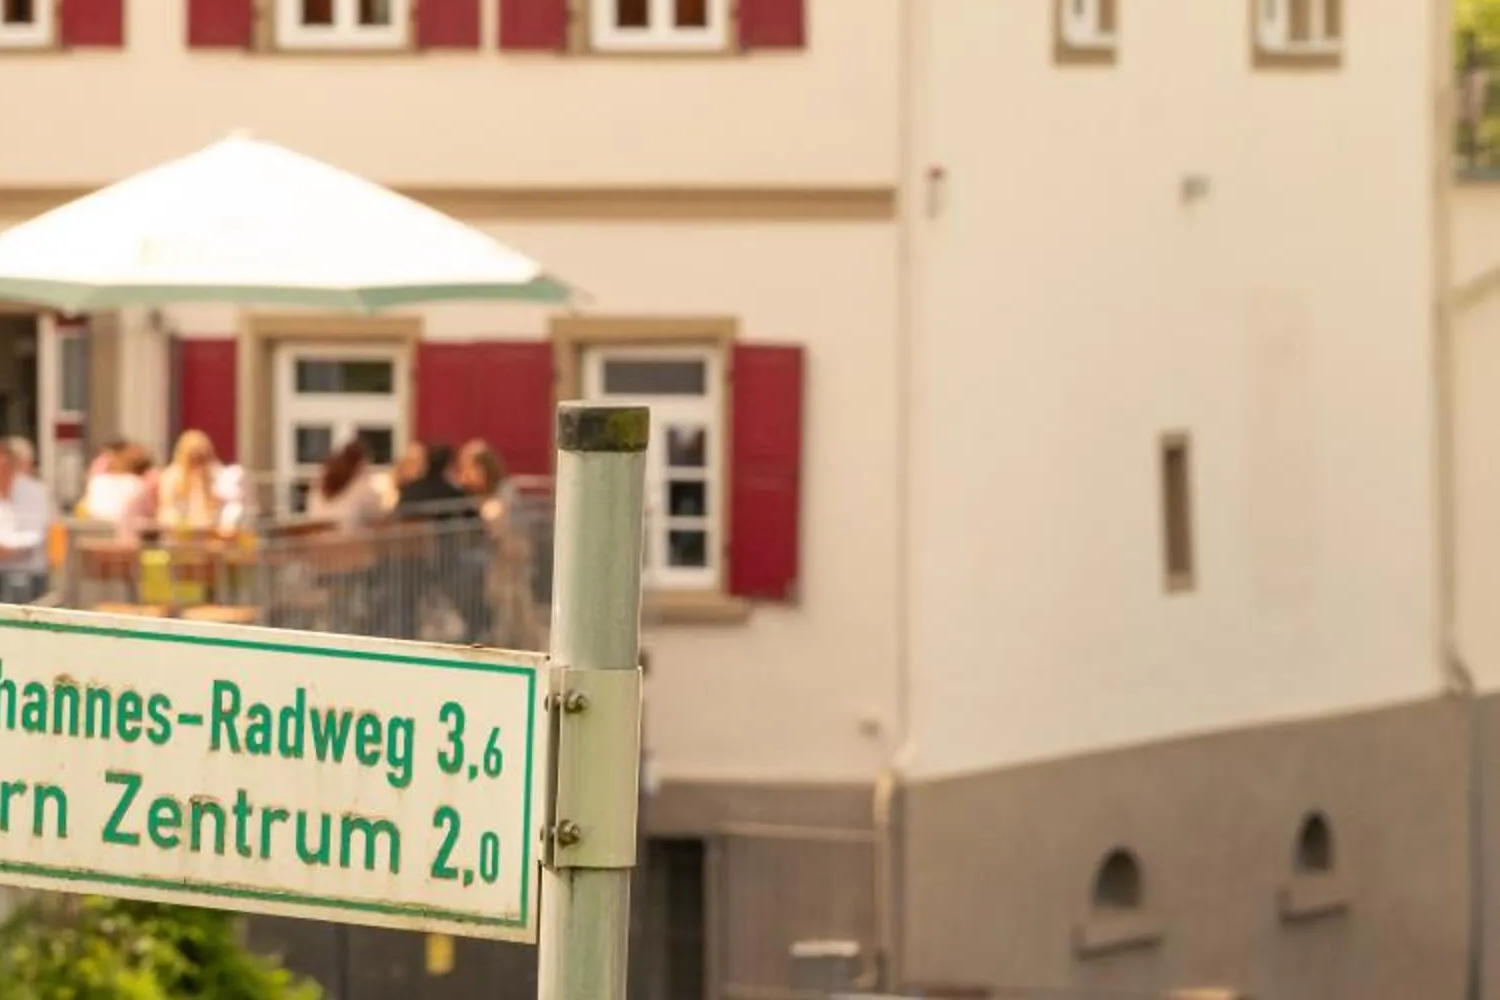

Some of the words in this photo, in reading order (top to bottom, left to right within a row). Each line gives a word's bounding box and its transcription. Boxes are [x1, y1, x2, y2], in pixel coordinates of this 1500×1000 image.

[436, 699, 506, 781] 3,6
[100, 772, 402, 875] Zentrum
[430, 803, 503, 886] 2,0
